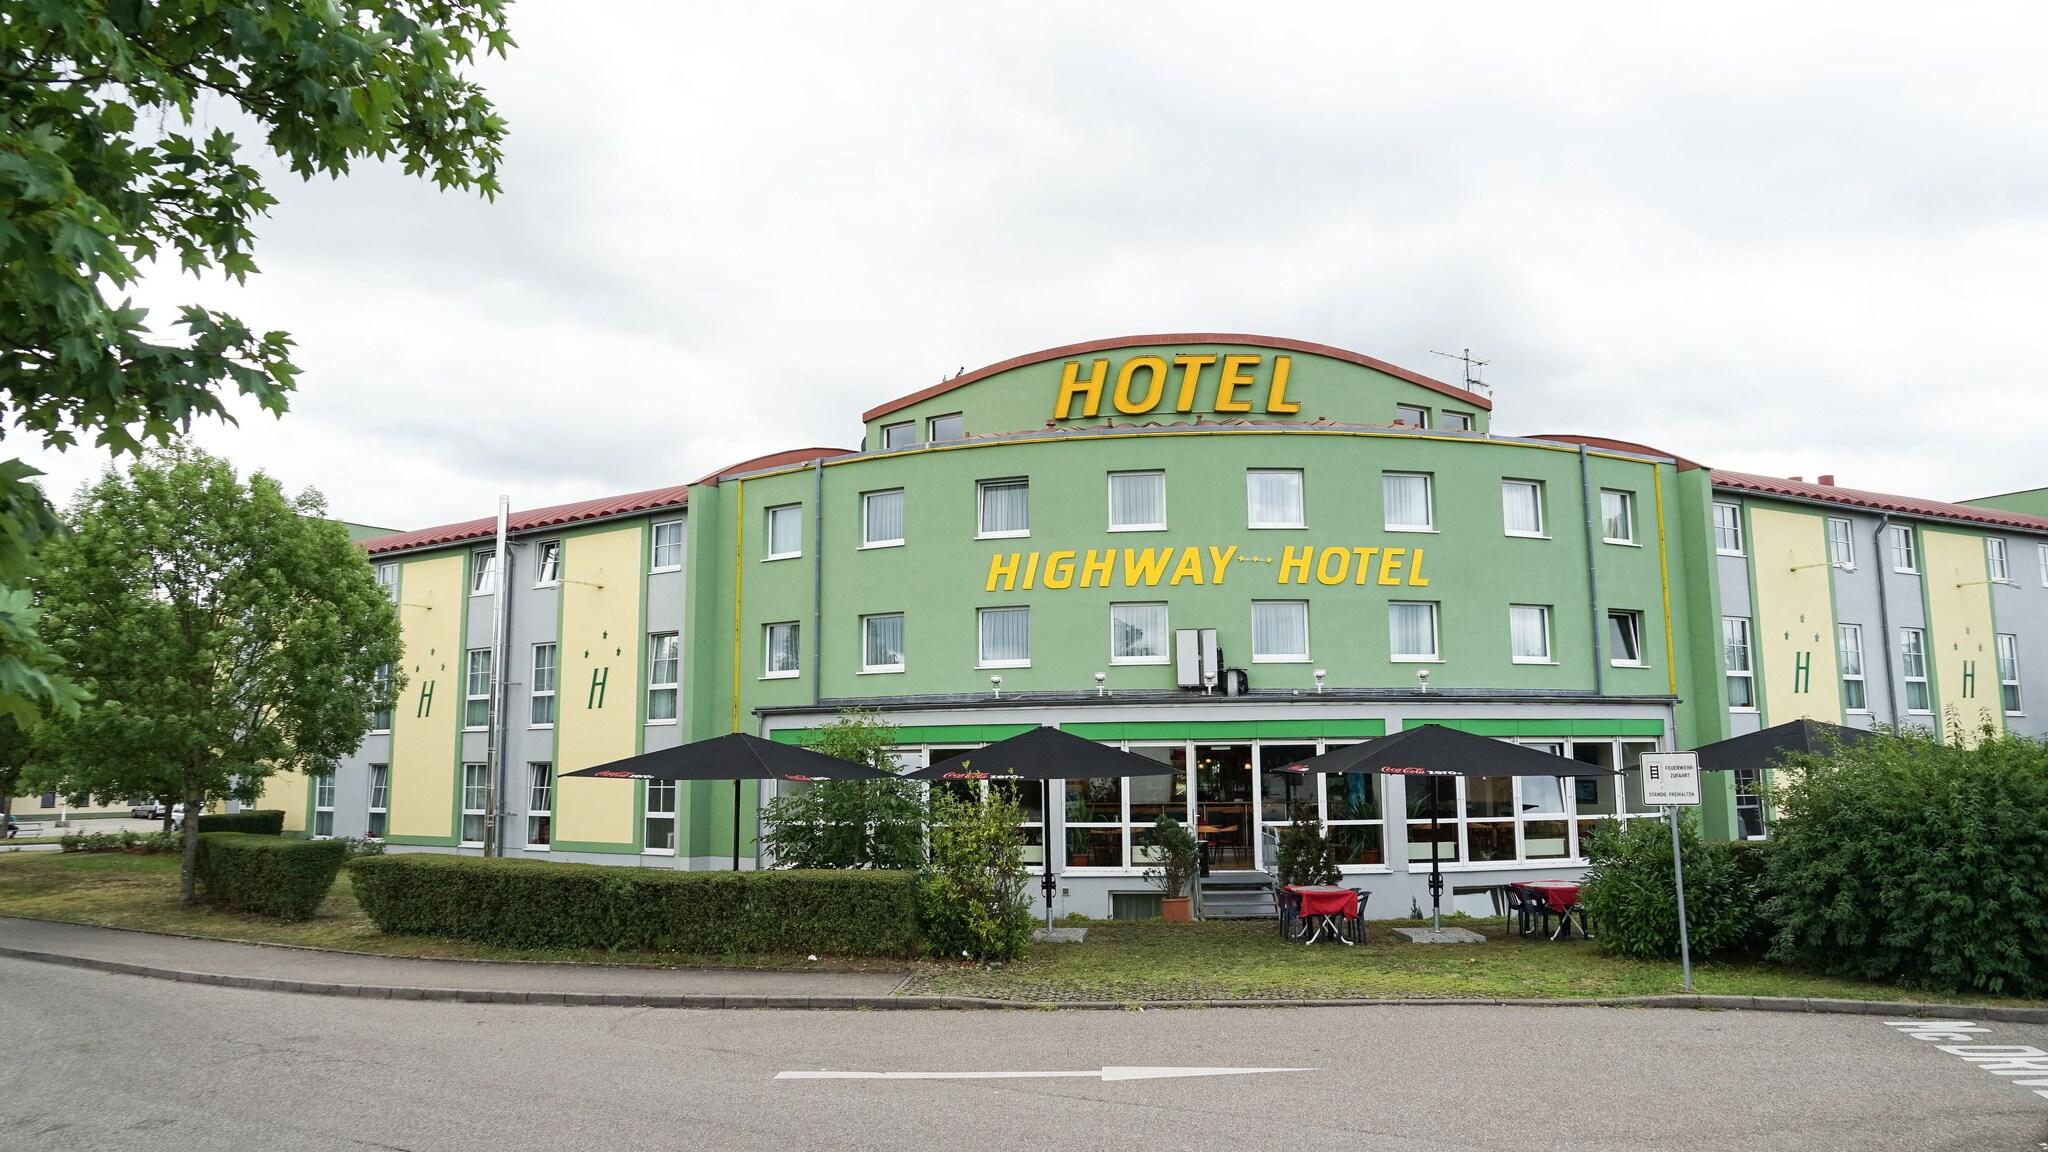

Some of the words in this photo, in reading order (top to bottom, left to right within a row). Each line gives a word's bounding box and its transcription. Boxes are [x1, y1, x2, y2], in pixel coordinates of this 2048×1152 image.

[1053, 353, 1301, 420] HOTEL
[986, 545, 1237, 592] HIGHWAY
[1278, 545, 1430, 586] HOTEL
[588, 667, 609, 709] H
[1794, 651, 1811, 693] H
[1963, 660, 1975, 698] H
[417, 680, 435, 718] H
